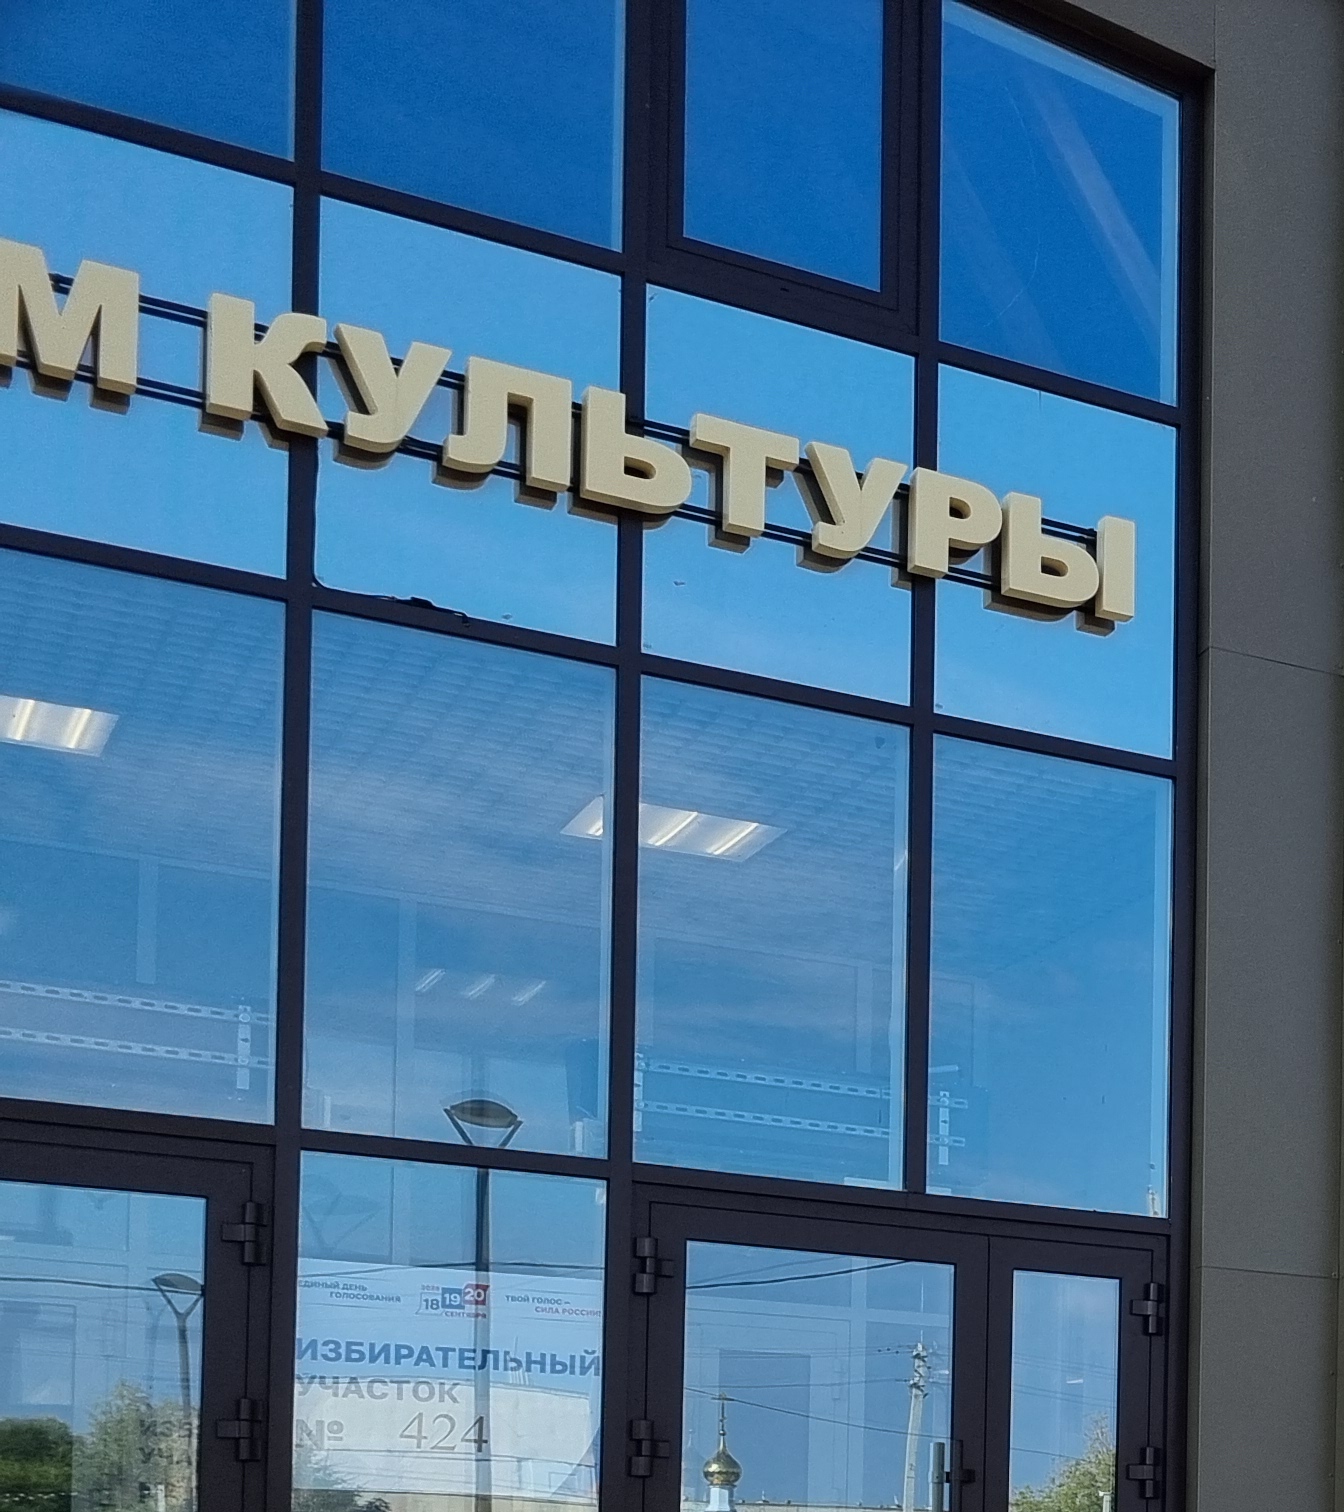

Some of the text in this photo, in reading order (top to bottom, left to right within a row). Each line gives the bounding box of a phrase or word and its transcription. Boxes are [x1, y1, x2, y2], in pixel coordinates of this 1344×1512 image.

[205, 292, 1136, 624] КУЛЬТУРЫ
[341, 1283, 368, 1292] ДЕНЬ
[330, 1291, 402, 1303] ГОЛОСОВАНИЯ
[443, 1293, 461, 1306] 19
[464, 1288, 485, 1301] 20
[505, 1294, 530, 1304] ТВОЙ
[531, 1296, 562, 1306] ГОЛОС
[423, 1298, 440, 1311] 18
[535, 1306, 560, 1315] СИЛА
[296, 1337, 600, 1377] ИЗБИРАТЕЛЬНЫЙ
[296, 1373, 460, 1404] УЧАСТОК
[399, 1412, 488, 1453] 424
